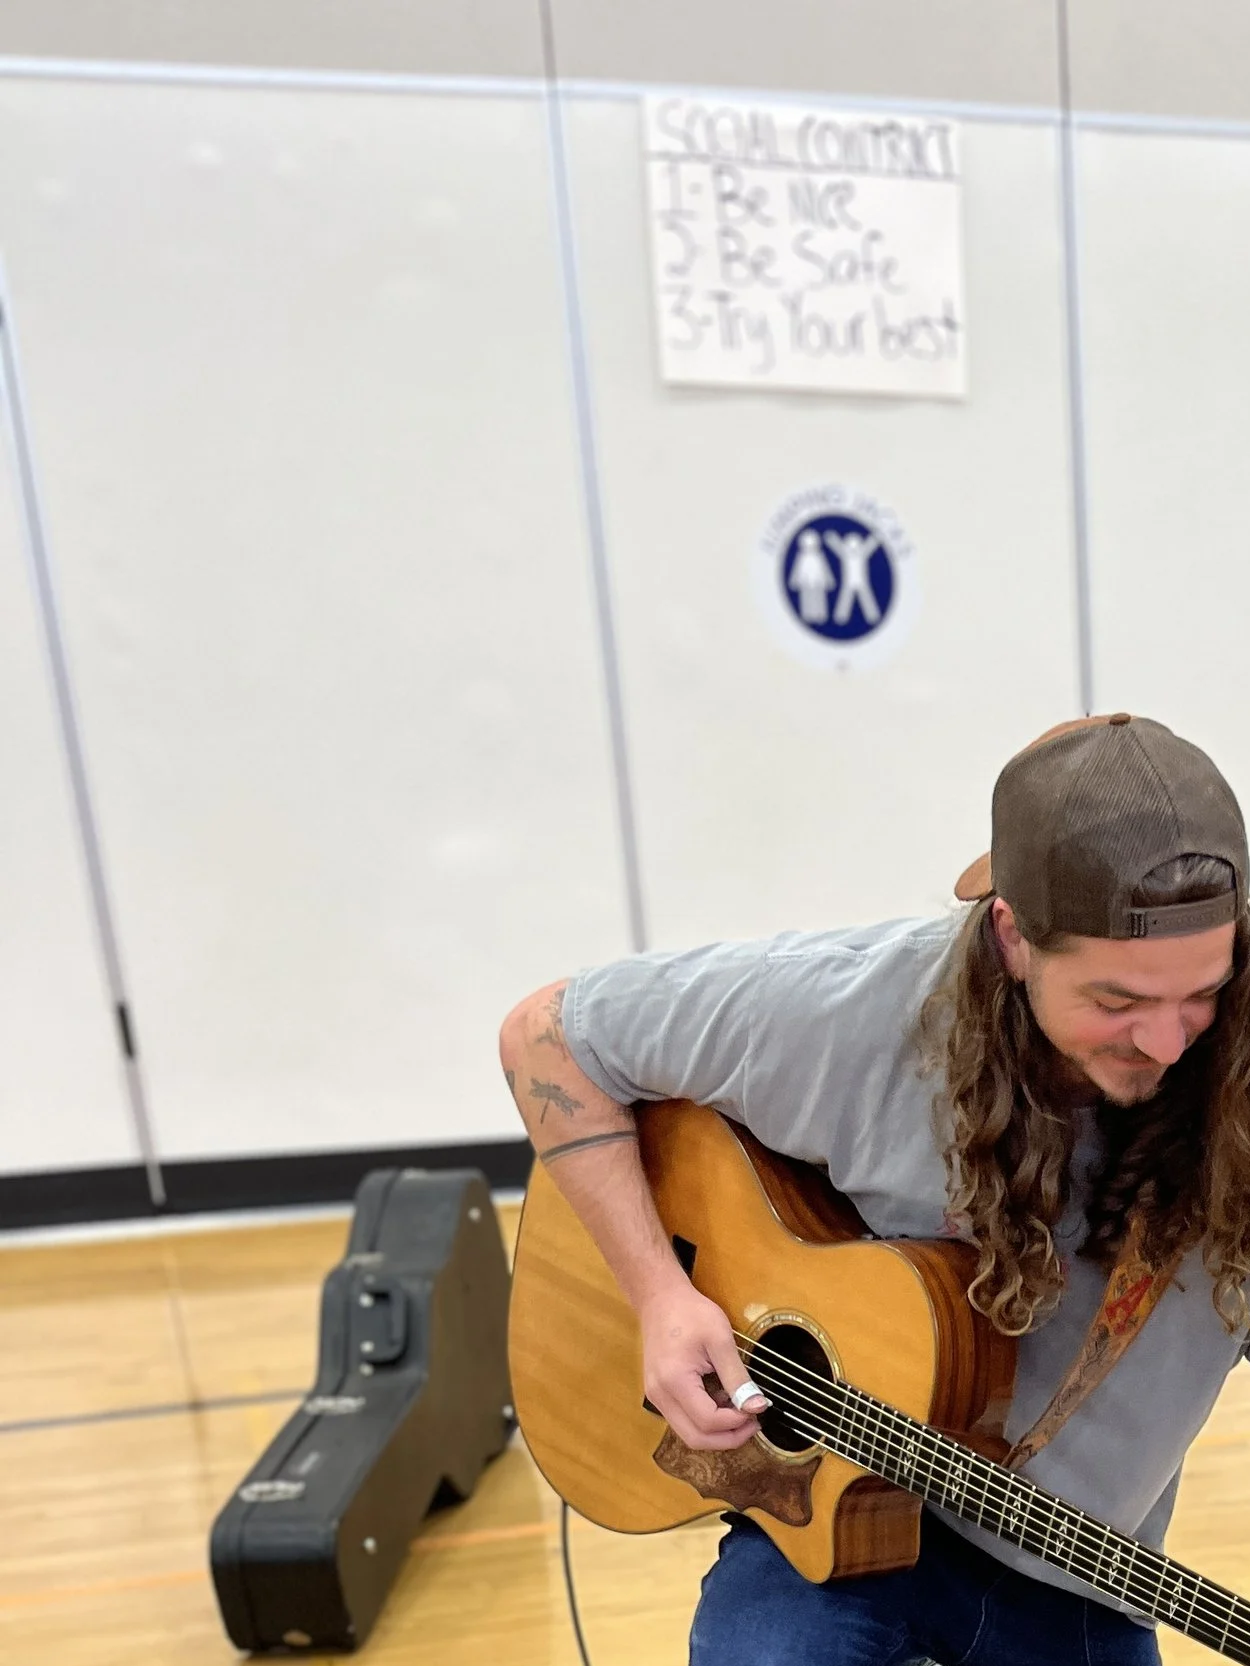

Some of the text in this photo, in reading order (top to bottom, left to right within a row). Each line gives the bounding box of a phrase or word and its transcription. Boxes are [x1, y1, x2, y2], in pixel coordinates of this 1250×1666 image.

[712, 163, 777, 227] Be
[717, 225, 783, 288] Be
[791, 229, 909, 296] Safe
